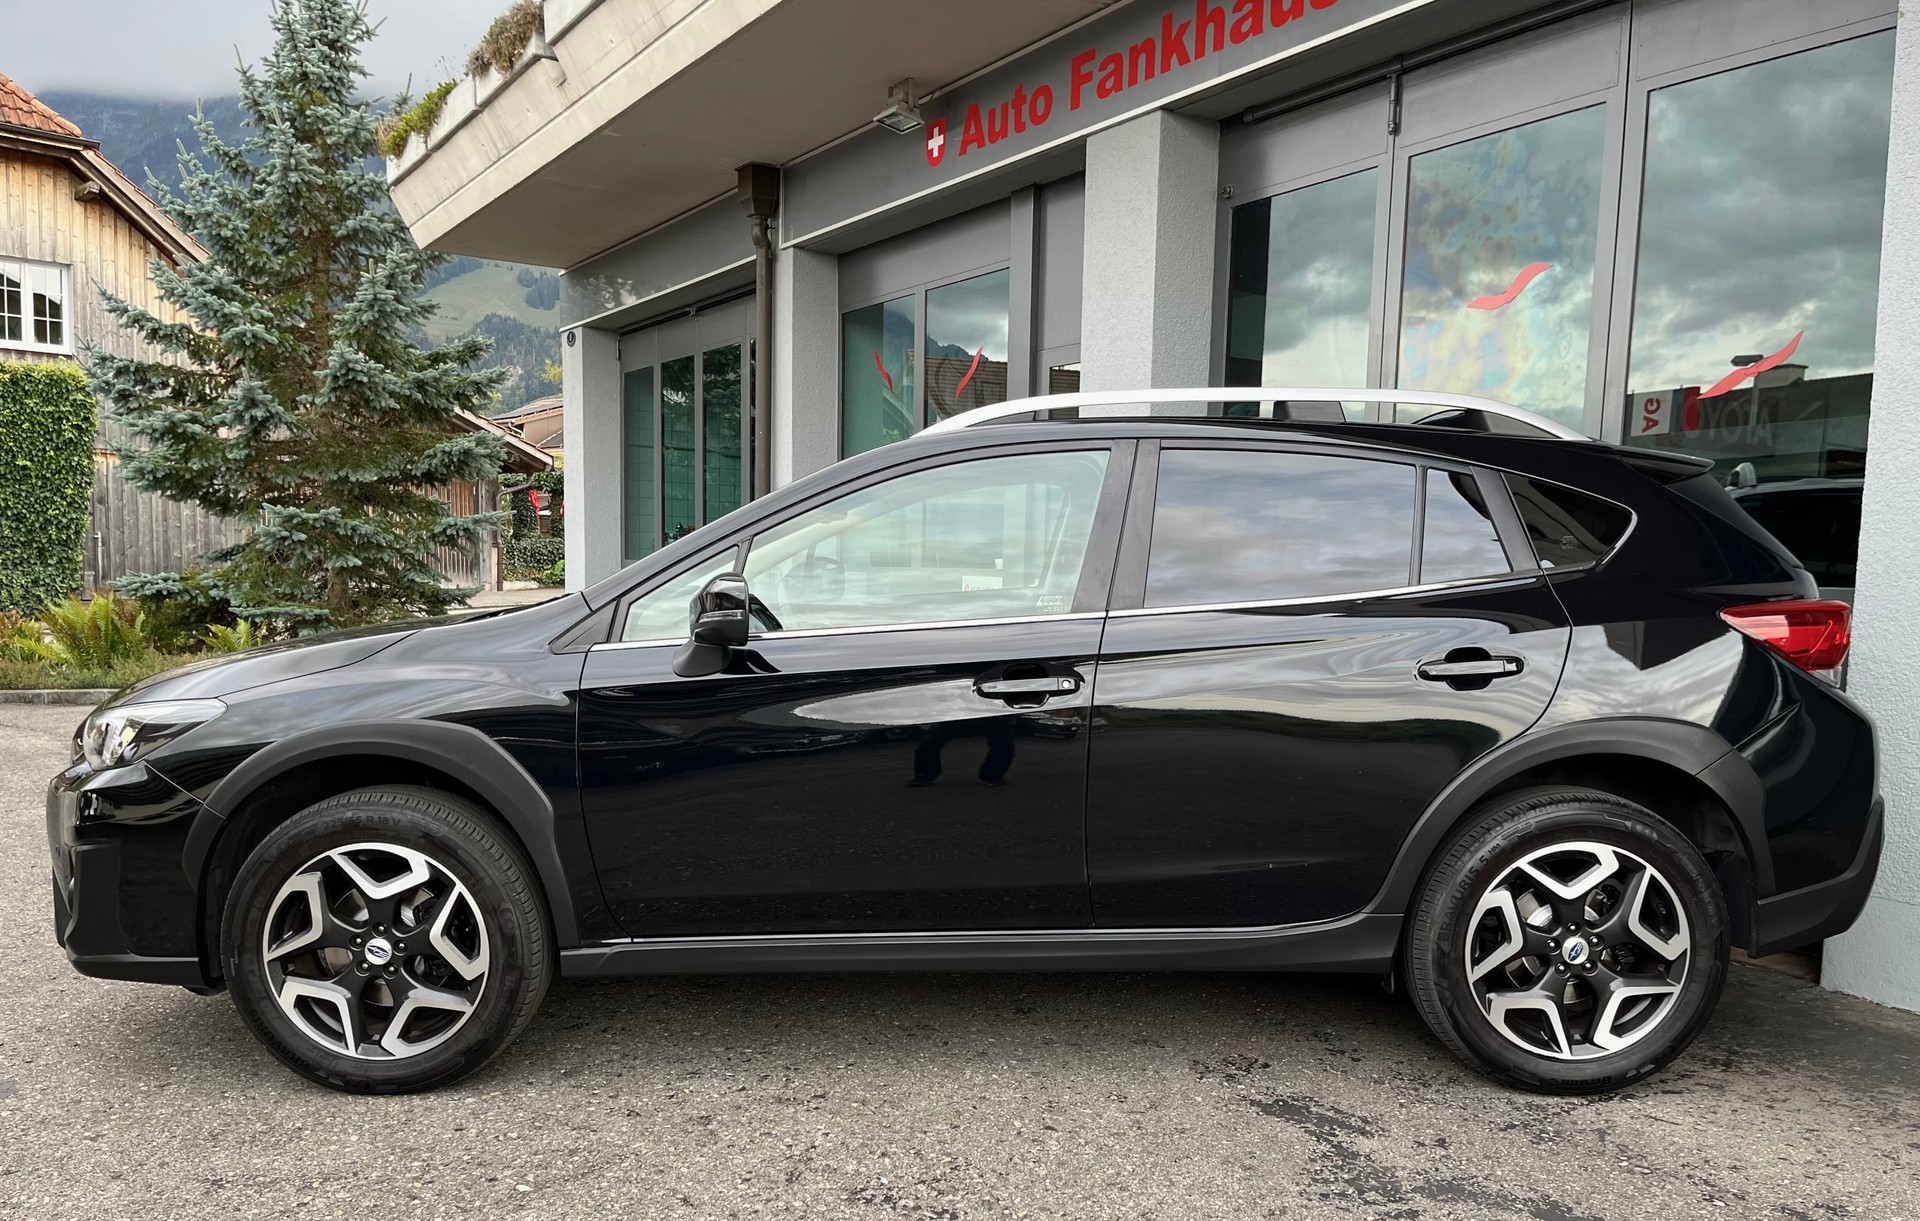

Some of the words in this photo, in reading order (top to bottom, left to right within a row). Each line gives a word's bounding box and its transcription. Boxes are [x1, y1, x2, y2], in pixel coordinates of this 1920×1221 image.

[958, 82, 1053, 157] Auto
[1070, 0, 1339, 112] Fankhau
[1437, 866, 1480, 942] BRAVURIS
[1479, 855, 1489, 867] 5
[1487, 843, 1503, 854] HM
